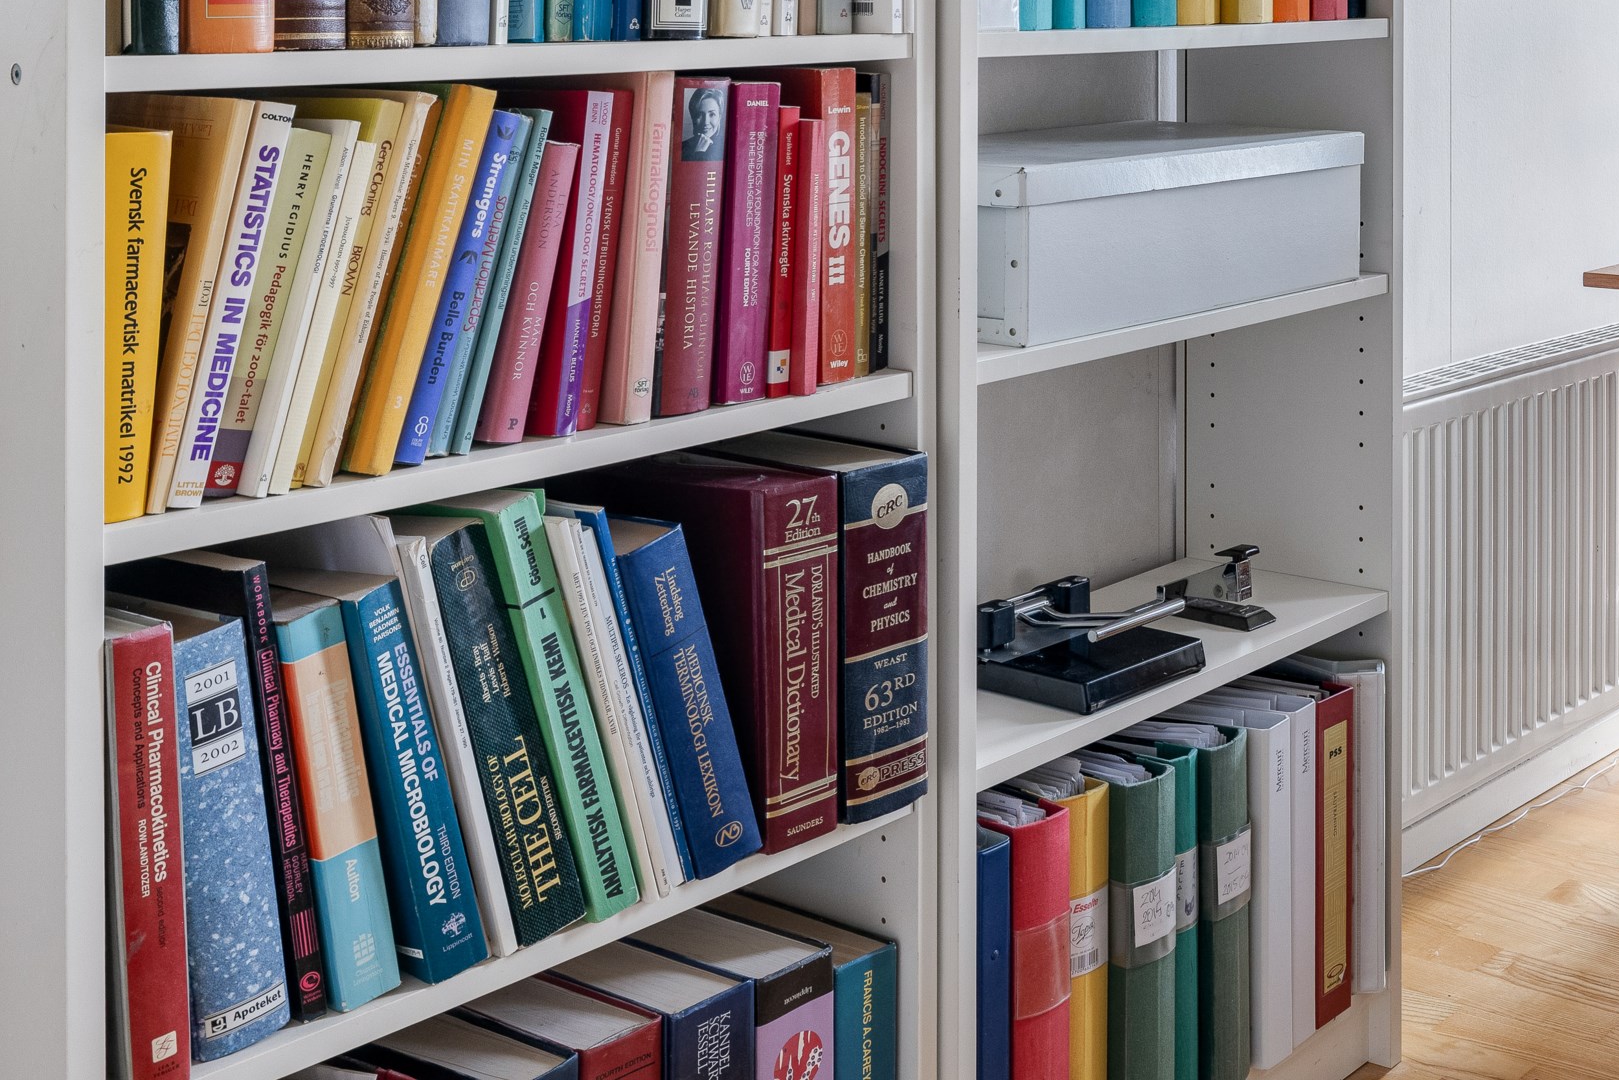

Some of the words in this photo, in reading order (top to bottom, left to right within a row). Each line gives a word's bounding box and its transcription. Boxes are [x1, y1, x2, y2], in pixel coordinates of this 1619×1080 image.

[261, 112, 293, 124] COLTON
[613, 127, 622, 150] Gunnar
[295, 153, 314, 199] HENRY
[610, 152, 620, 185] Richardson
[645, 121, 666, 252] farmakognosi
[828, 131, 850, 249] GENES
[879, 137, 887, 198] ENDOCRINE
[127, 167, 147, 232] Svensk
[230, 145, 280, 287] STATISTICS
[361, 172, 384, 217] Cloning
[471, 152, 507, 239] Strangers
[704, 171, 717, 235] HILLARY
[746, 190, 754, 227] SCIENCES
[278, 204, 301, 259] EGIDIUS
[481, 195, 508, 258] Methods
[688, 203, 701, 272] LEVANDE
[341, 245, 363, 296] BROWN
[859, 248, 867, 289] Chemistry
[123, 237, 144, 355] farmacevtisk
[221, 297, 247, 324] IN
[259, 265, 287, 330] Pedagogik
[444, 290, 466, 327] Belle
[683, 279, 697, 351] HISTORIA
[428, 332, 454, 385] Burden
[512, 317, 531, 381] KVINNOR
[569, 357, 577, 383] BELFUS
[119, 361, 137, 439] matrikel
[190, 333, 238, 461] MEDICINE
[236, 354, 261, 424] 2000-talet
[118, 445, 134, 484] 1992
[784, 494, 821, 529] 27th
[877, 494, 903, 519] CRC
[784, 526, 822, 544] Edition
[867, 542, 912, 564] HANDBOOK
[451, 554, 475, 572] Garland
[527, 549, 542, 586] Göran
[863, 573, 918, 599] CHEMISTRY
[253, 574, 269, 644] WORKBOOK
[374, 603, 391, 617] VOLK
[654, 572, 675, 637] Zetterberg
[666, 566, 684, 622] Lindskog
[785, 569, 807, 662] Medical
[368, 607, 399, 629] BENJAMIN
[373, 616, 398, 635] KADNER
[487, 623, 499, 656] Watson
[870, 609, 911, 633] PHYSICS
[260, 649, 278, 698] Clinical
[472, 645, 481, 666] Bray
[541, 632, 567, 682] KEMI
[604, 615, 617, 653] MULTIPEL
[615, 654, 630, 690] SKLEROS
[874, 653, 908, 670] WEAST
[145, 661, 163, 726] Clinical
[194, 671, 230, 694] 2001
[478, 671, 491, 703] Alberts
[685, 644, 714, 728] MEDICINSK
[191, 697, 239, 741] LB
[266, 694, 282, 755] Pharmacy
[394, 641, 431, 756] ESSENTIALS
[421, 758, 438, 782] OF
[673, 648, 707, 752] TERMINOLOGI
[698, 750, 724, 818] LEXIKON
[780, 661, 806, 781] Dictionary
[863, 701, 918, 730] EDITION
[200, 740, 240, 764] 2002
[553, 680, 600, 810] FARMACEVTISK
[880, 750, 926, 779] PRESS
[1302, 729, 1310, 774] Mercuri
[1328, 745, 1343, 760] PSS
[377, 650, 409, 751] MEDICAL
[398, 749, 447, 906] MICROBIOLOGY
[503, 735, 544, 826] CELL
[1275, 750, 1284, 793] Mercuri
[148, 727, 170, 883] Pharmacokinetics
[276, 774, 296, 848] Therapeutics
[787, 816, 824, 837] SAUNDERS
[437, 823, 452, 856] THIRD
[586, 807, 624, 899] ANALYTISK
[346, 858, 360, 902] Aulton
[444, 857, 461, 900] EDITION
[524, 824, 561, 903] THE
[1073, 897, 1099, 914] Esselte
[442, 933, 473, 952] Lippincott
[233, 989, 282, 1021] Apoteket
[784, 986, 813, 1005] Lippincott
[862, 969, 873, 1025] FRANCIS
[719, 1010, 731, 1074] KANDEL
